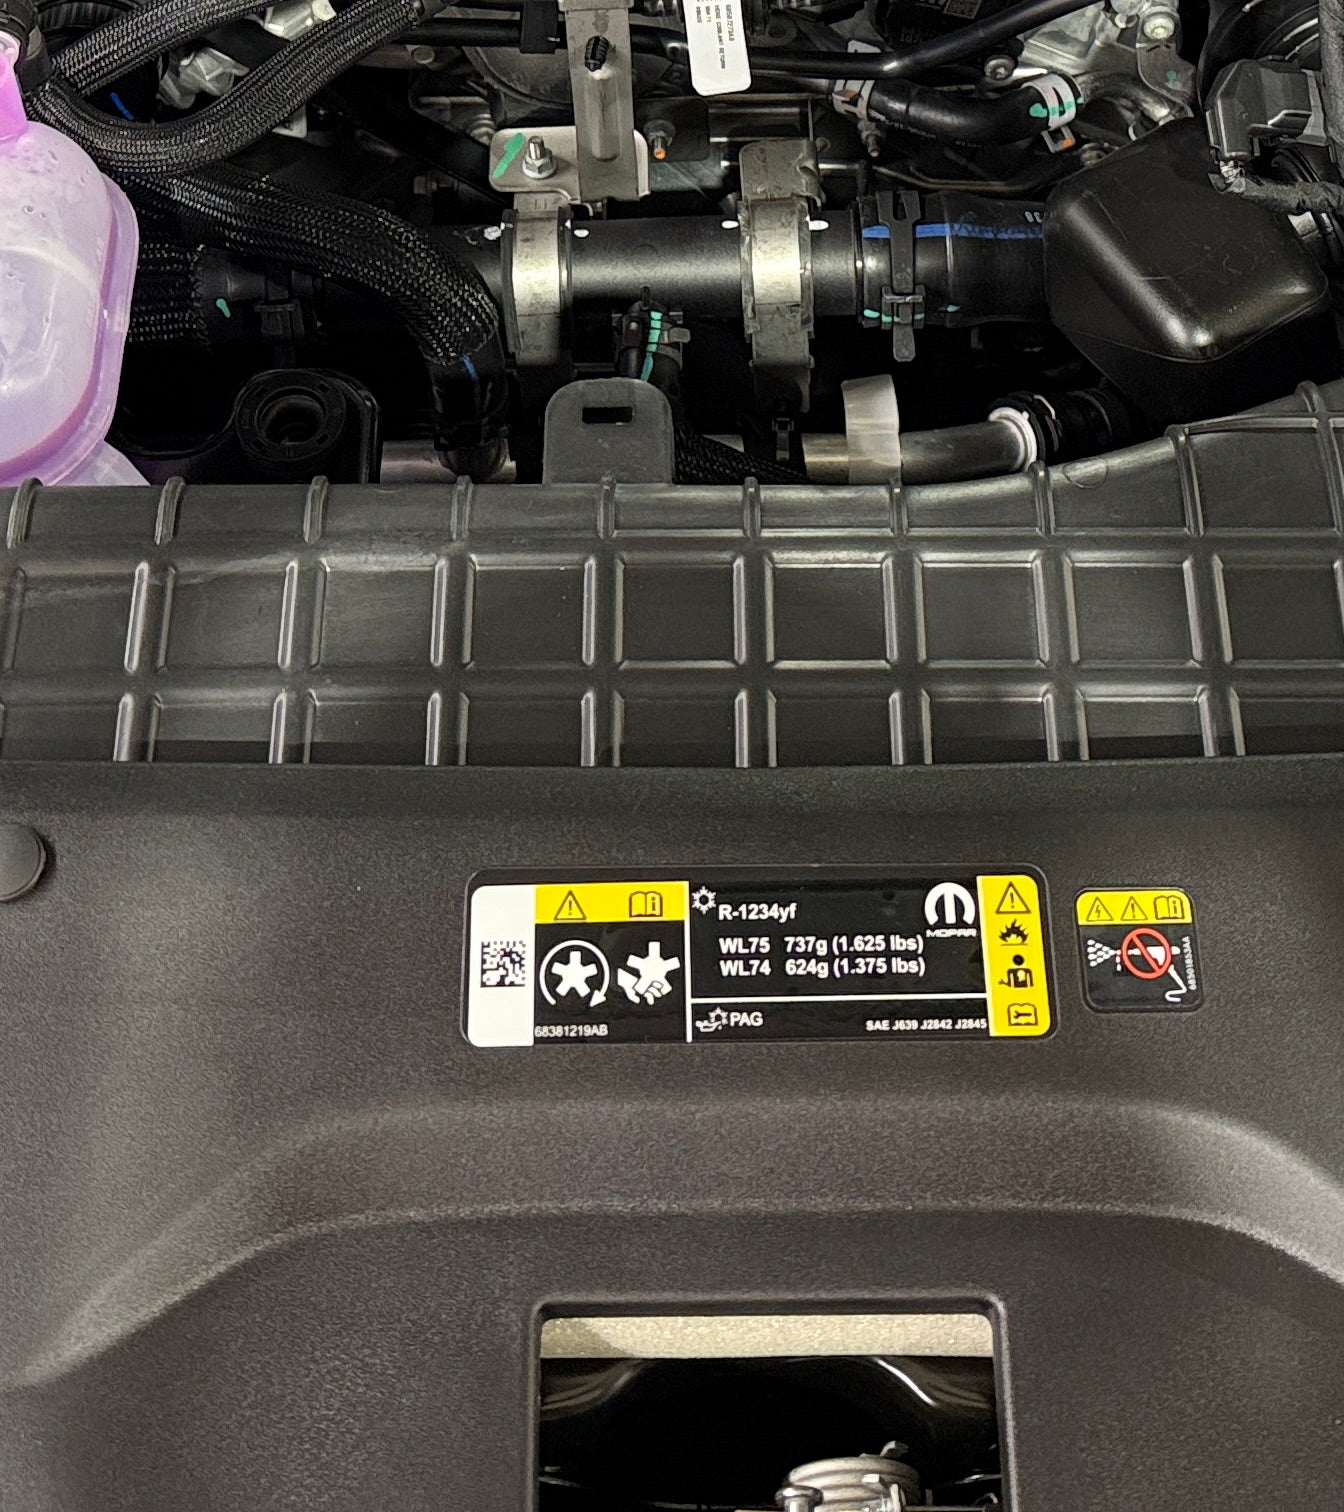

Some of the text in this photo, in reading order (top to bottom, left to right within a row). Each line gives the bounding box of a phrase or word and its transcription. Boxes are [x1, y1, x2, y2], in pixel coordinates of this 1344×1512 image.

[718, 902, 798, 924] R-1234yf
[925, 927, 977, 938] MOPAR
[718, 934, 924, 956] WL75 737g (1.625 lbs)
[719, 957, 926, 978] WL74 624g (1.375 lbs)
[729, 1011, 764, 1027] PAG
[865, 1018, 987, 1031] SAE J639 J2842 J2845
[534, 1024, 609, 1038] 68381219AB
